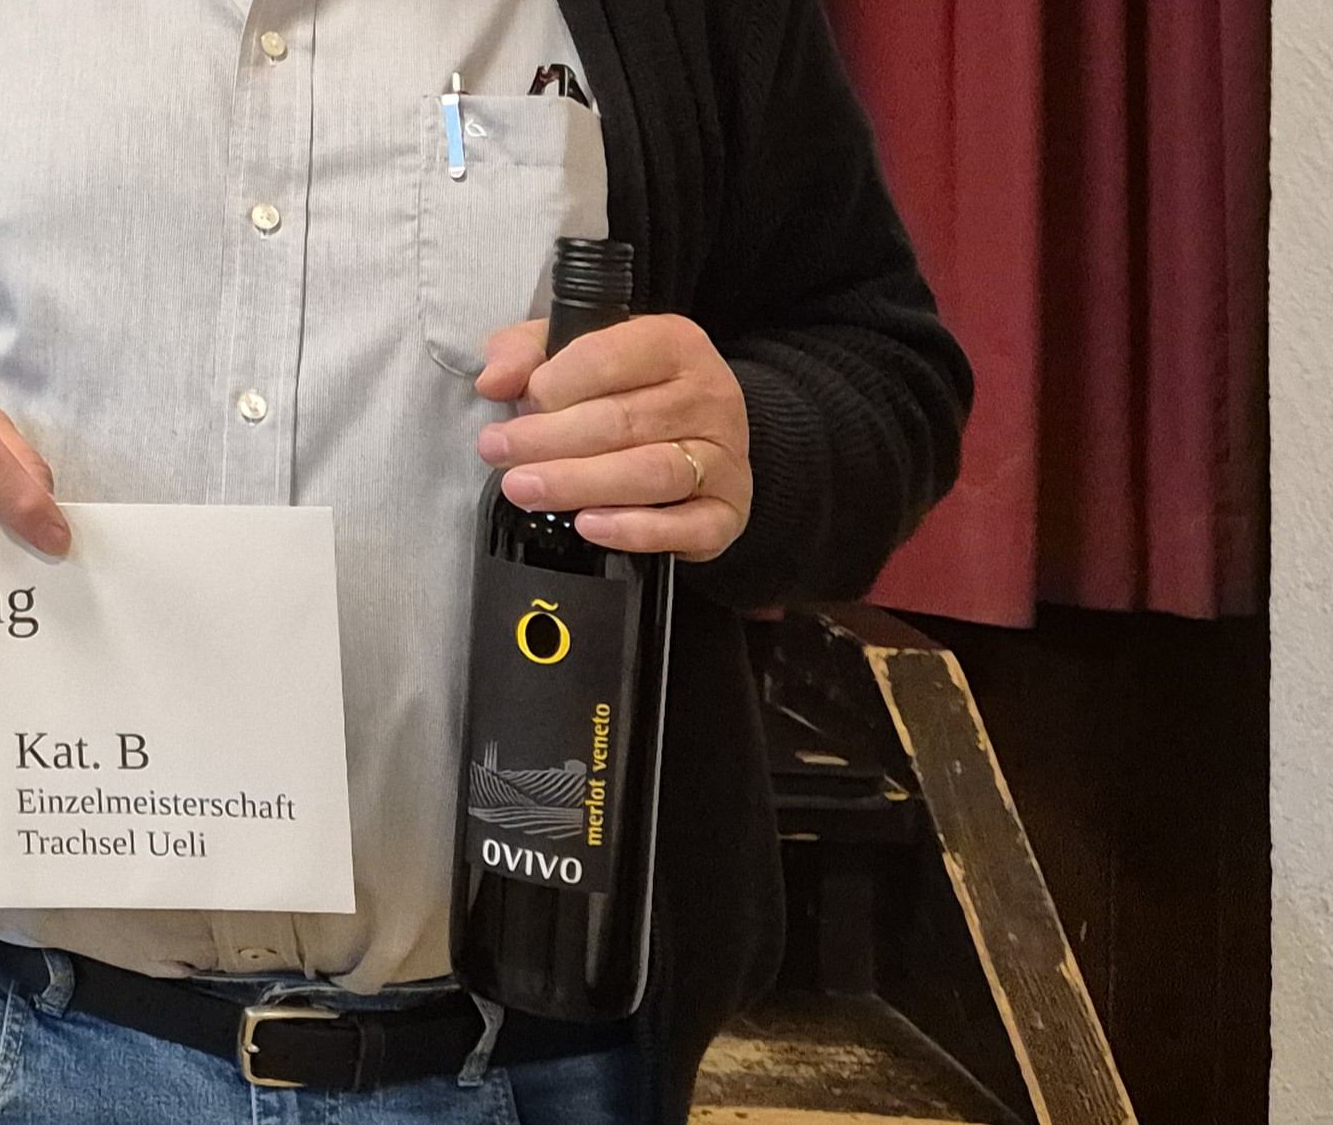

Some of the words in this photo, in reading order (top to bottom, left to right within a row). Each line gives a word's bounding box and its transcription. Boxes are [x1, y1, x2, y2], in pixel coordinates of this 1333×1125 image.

[14, 732, 101, 770] Kat.
[115, 732, 150, 770] B
[591, 702, 611, 772] veneto
[16, 786, 296, 821] Einzelmeisterschaft
[584, 778, 607, 846] merlot
[17, 828, 136, 857] Trachsel
[146, 830, 207, 858] Ueli
[482, 839, 583, 884] OVIVO
